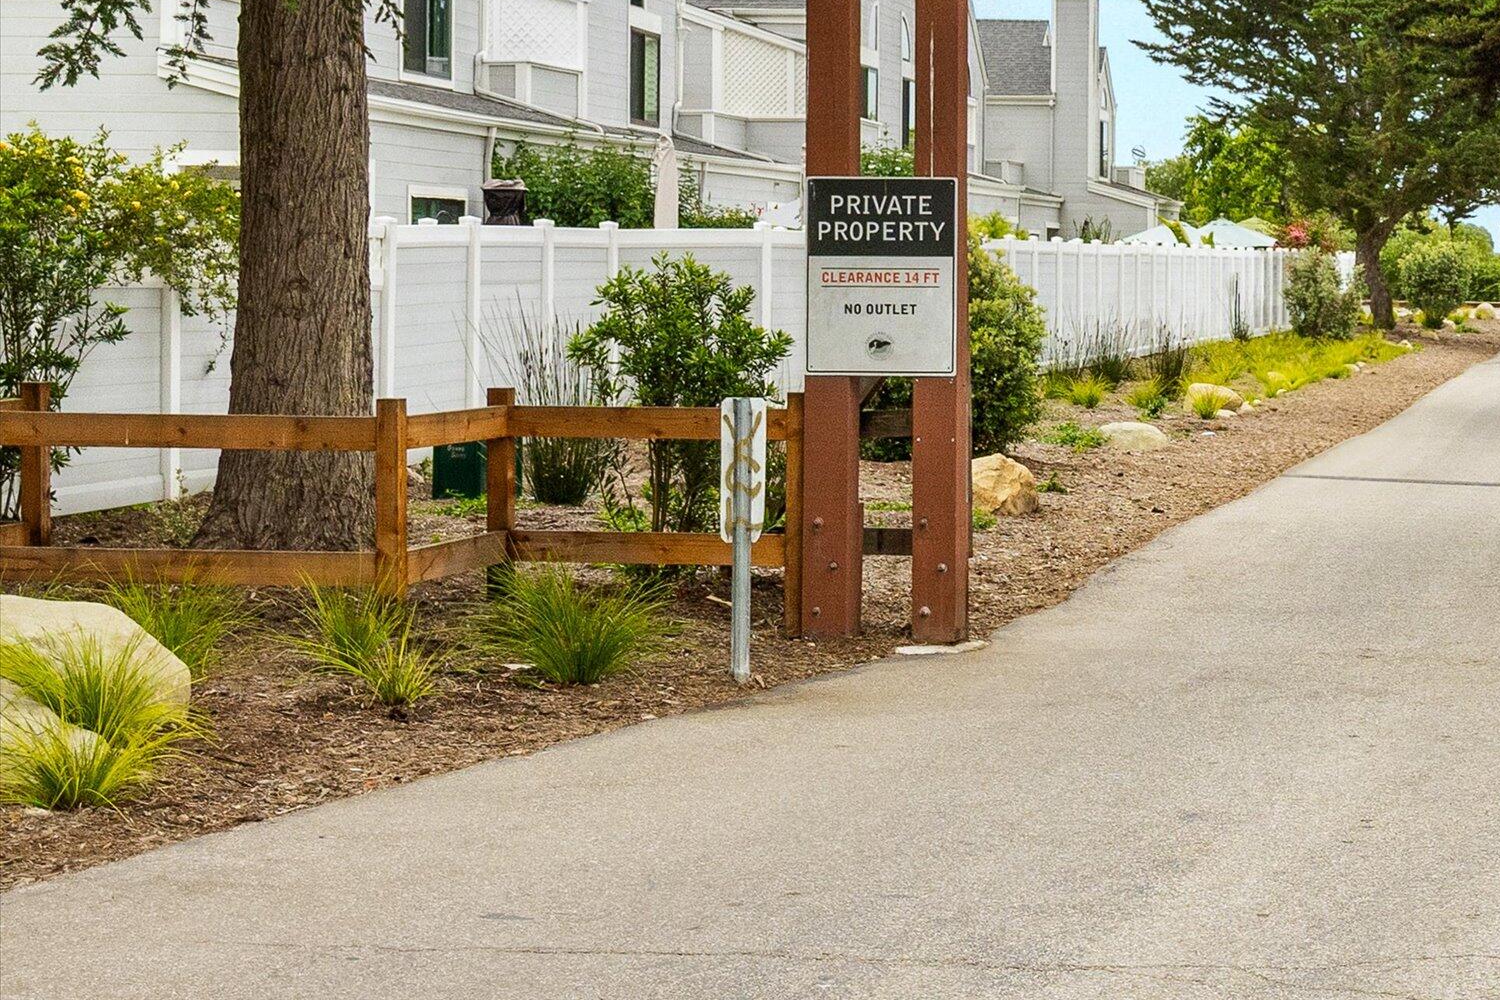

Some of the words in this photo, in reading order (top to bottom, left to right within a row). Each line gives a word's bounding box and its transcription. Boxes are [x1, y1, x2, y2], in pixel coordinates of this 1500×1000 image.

[830, 195, 933, 215] PRIVATE
[817, 221, 946, 242] PROPERTY
[821, 271, 901, 284] CLEARANCE
[904, 272, 920, 284] 14
[923, 272, 940, 284] FT
[844, 303, 862, 315] NO
[866, 303, 917, 315] OUTLET
